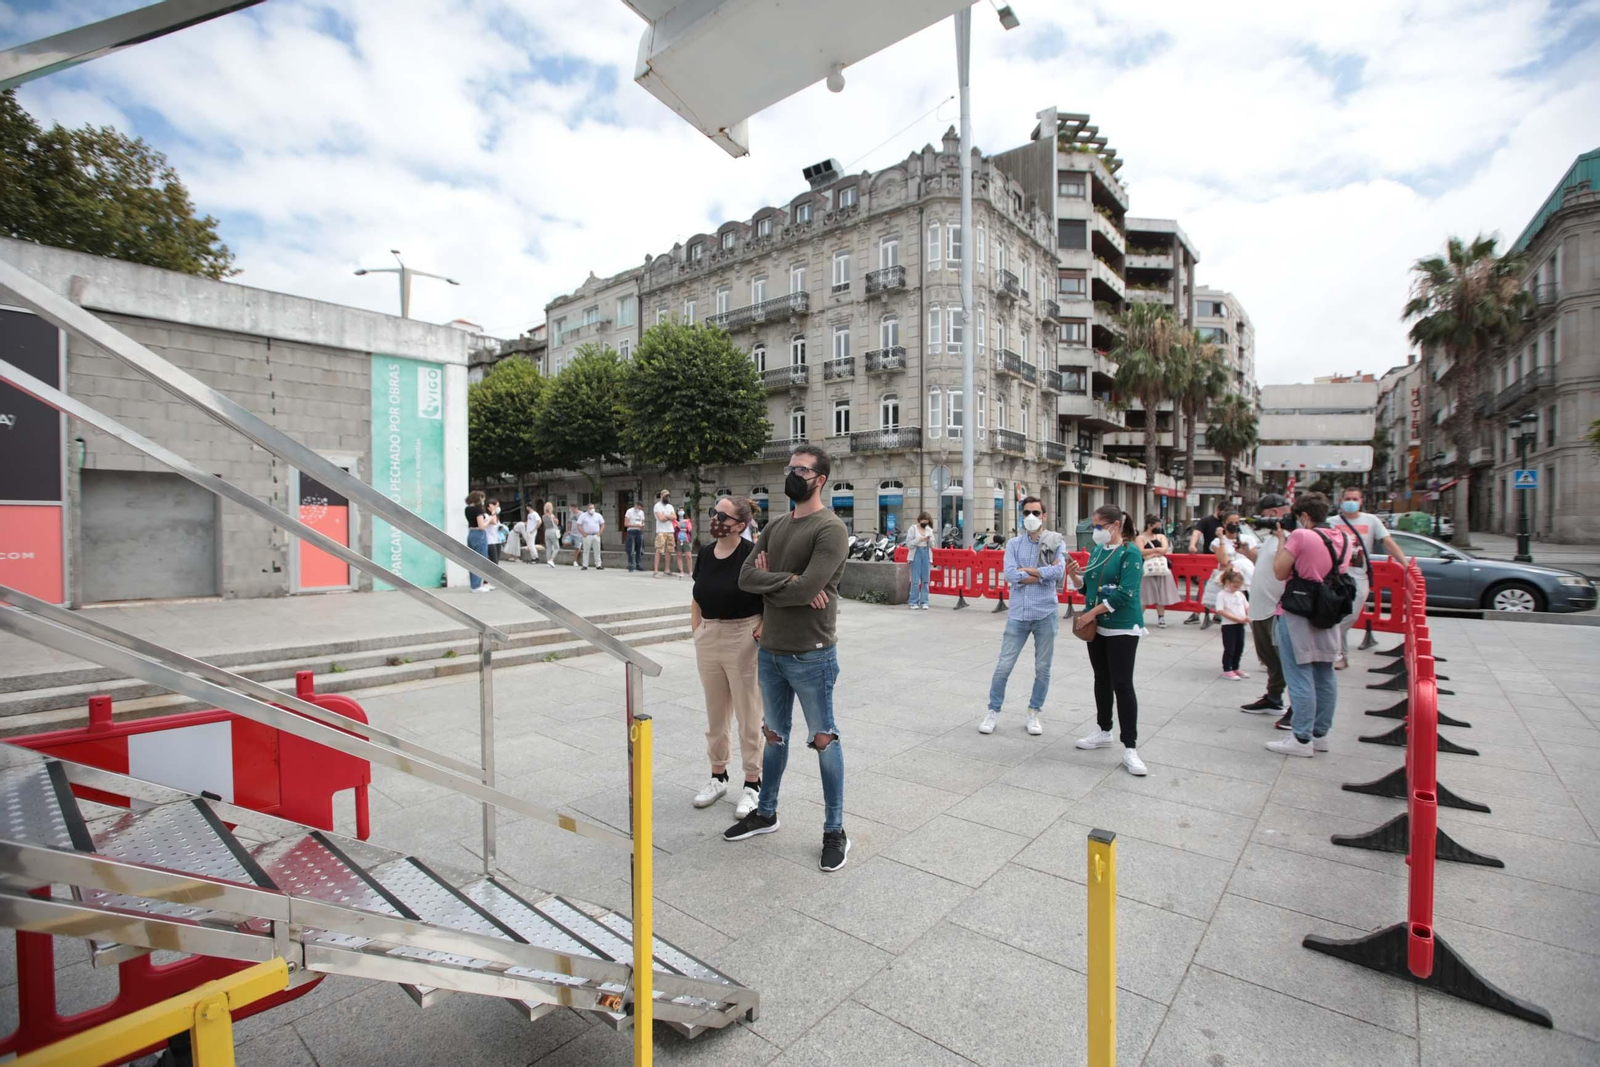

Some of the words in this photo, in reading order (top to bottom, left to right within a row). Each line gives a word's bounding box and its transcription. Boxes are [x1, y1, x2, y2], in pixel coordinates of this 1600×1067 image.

[388, 363, 400, 405] OBRAS
[427, 369, 438, 404] VIGO
[389, 406, 401, 432] POR
[1410, 387, 1421, 440] HOTEL
[389, 433, 401, 492] PECHADO
